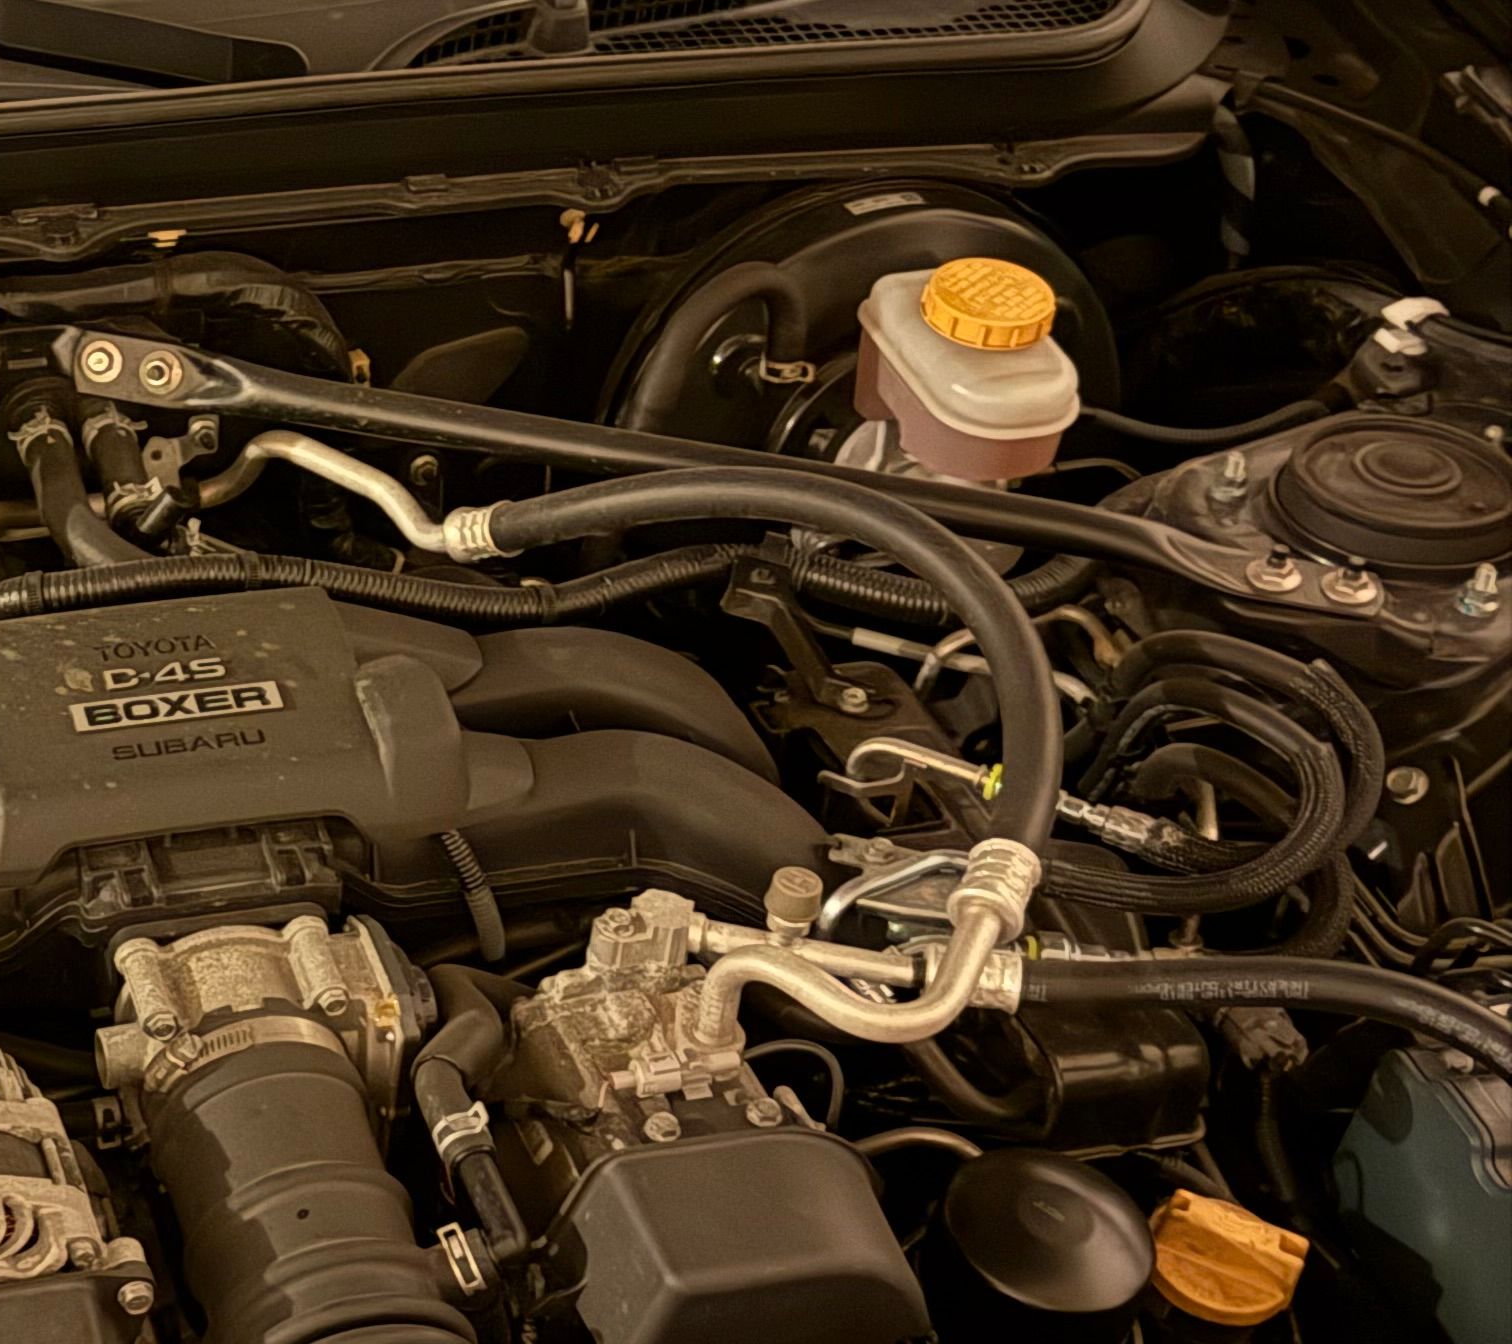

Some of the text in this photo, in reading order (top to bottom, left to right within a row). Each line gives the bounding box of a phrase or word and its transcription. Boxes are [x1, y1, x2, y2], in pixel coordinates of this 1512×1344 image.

[93, 634, 216, 662] TOYOTA
[103, 656, 227, 691] D-4S
[85, 685, 272, 727] BOXER
[112, 729, 266, 761] SUBARU
